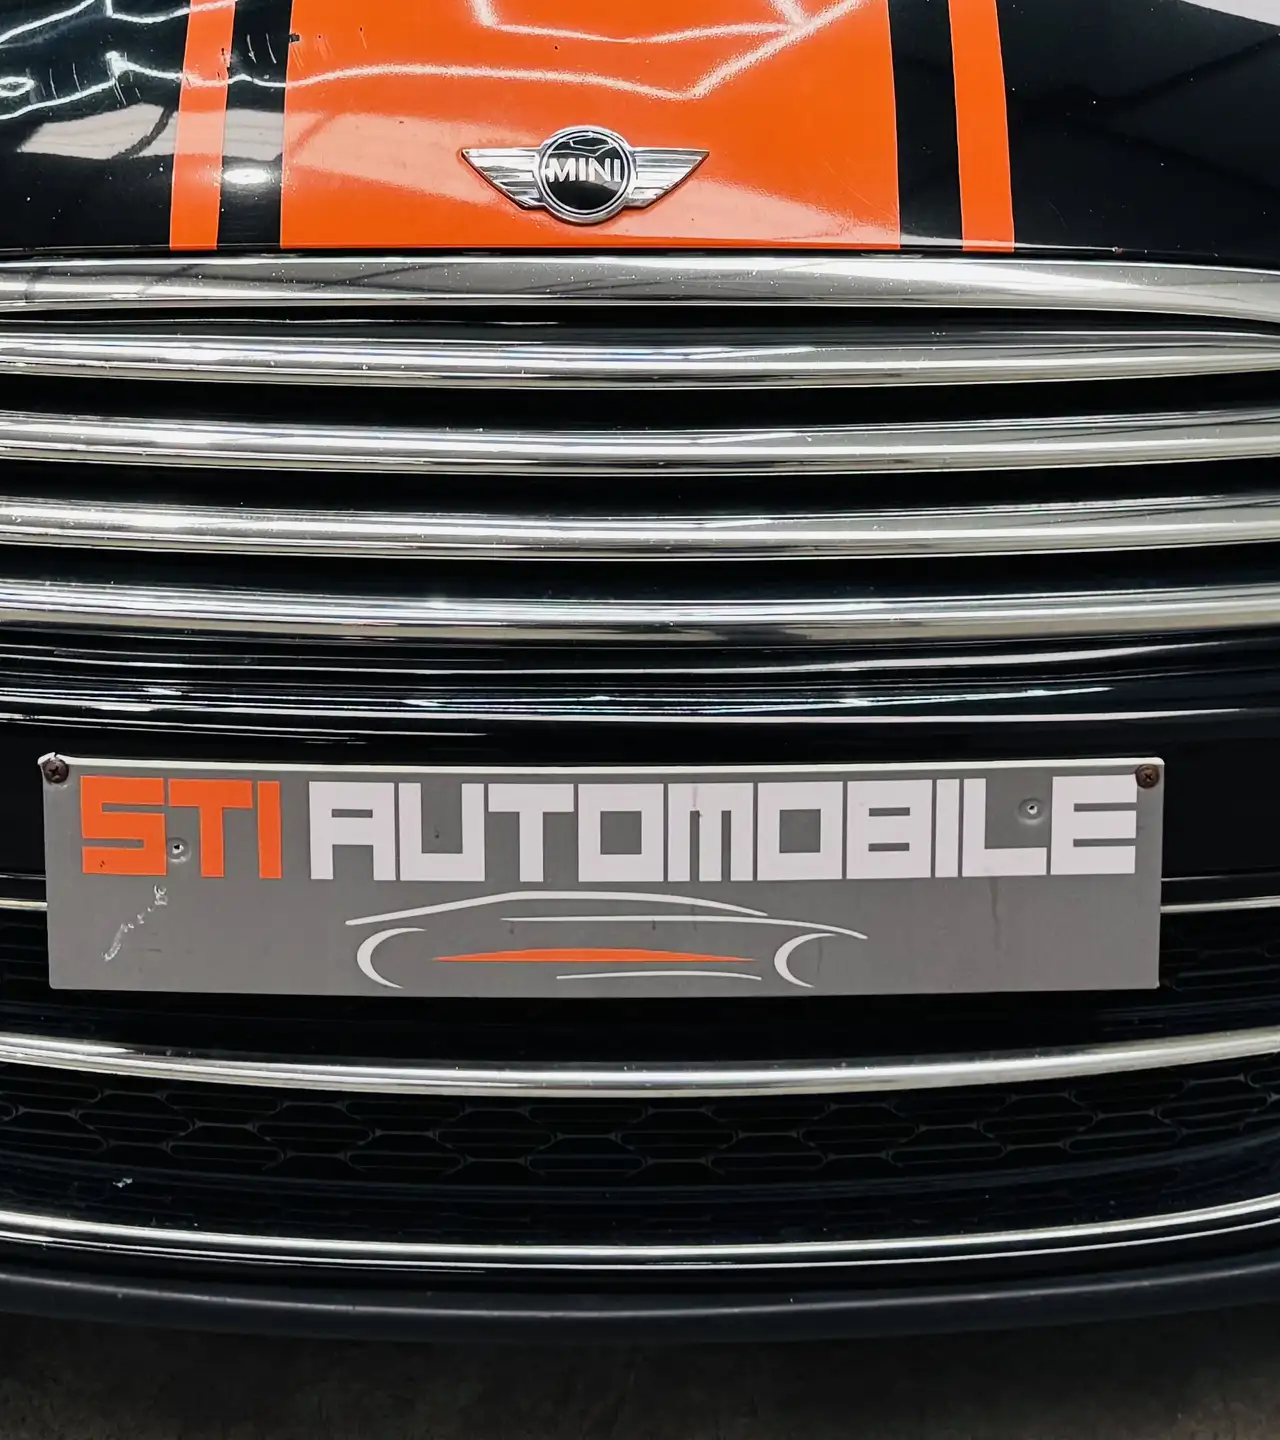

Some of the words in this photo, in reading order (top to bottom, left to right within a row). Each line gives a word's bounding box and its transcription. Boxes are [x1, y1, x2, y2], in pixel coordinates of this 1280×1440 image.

[547, 156, 622, 184] MINI
[79, 775, 284, 880] STI
[308, 774, 1138, 882] AUTOMOBILE
